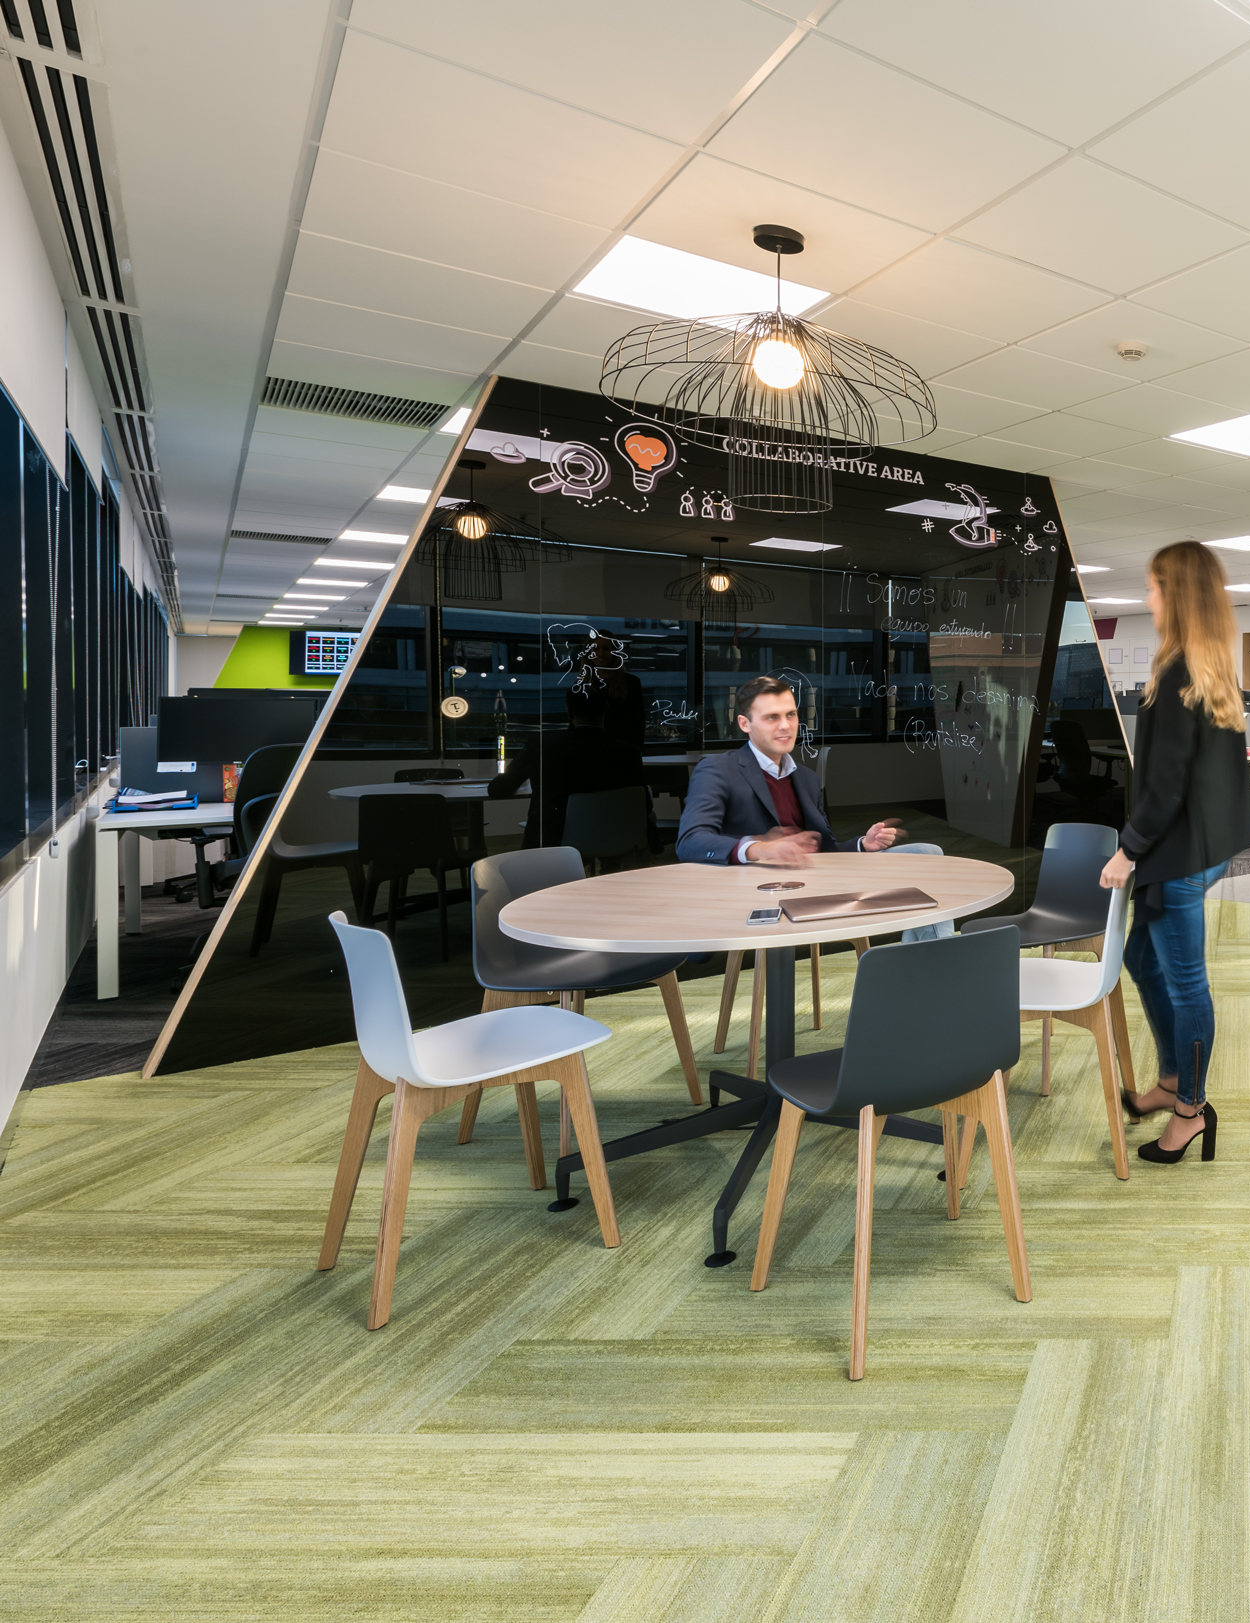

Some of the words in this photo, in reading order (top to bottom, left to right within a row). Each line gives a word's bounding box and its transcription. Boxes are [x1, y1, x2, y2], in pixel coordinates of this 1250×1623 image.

[722, 437, 878, 477] COLLABORATIVE
[880, 465, 925, 485] AREA
[866, 572, 935, 605] Somos
[950, 589, 968, 608] un
[880, 615, 930, 648] equipo
[939, 618, 992, 648] estupendo
[849, 660, 899, 701] Nada
[914, 682, 949, 701] nos
